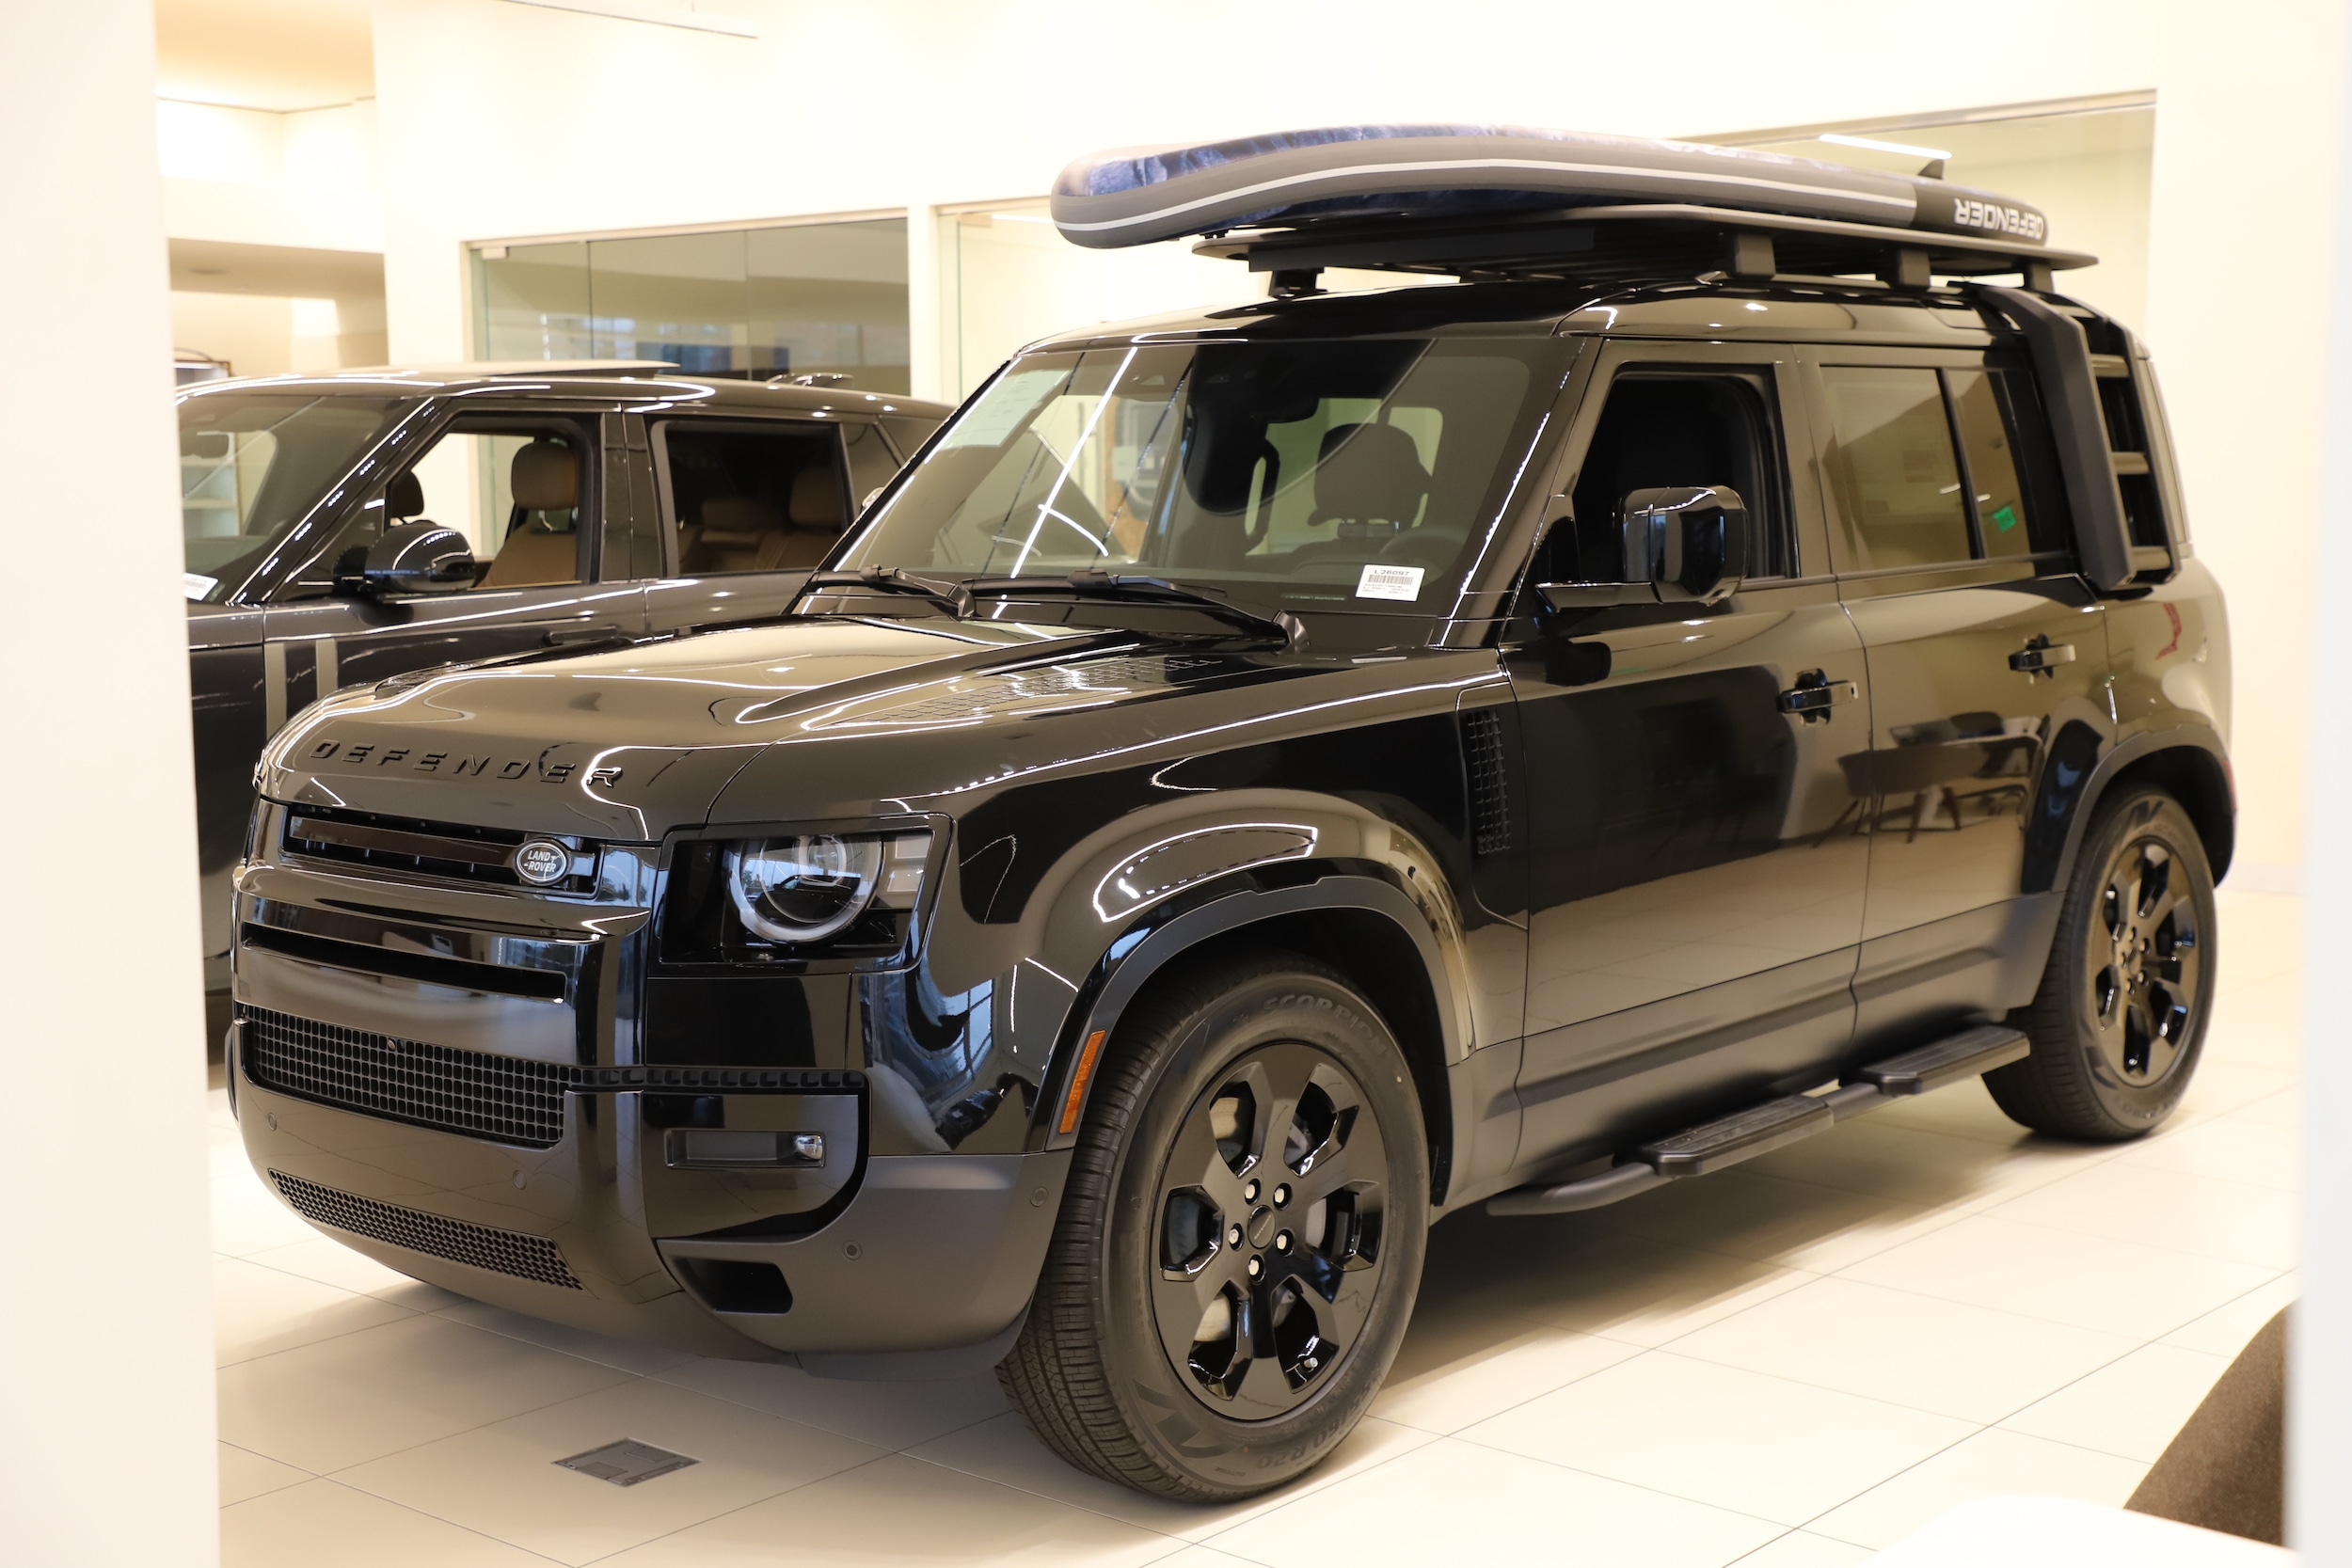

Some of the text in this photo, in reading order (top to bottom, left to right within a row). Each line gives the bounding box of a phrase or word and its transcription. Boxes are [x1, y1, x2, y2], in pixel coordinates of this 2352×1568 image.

[1954, 198, 2043, 240] DEFENDER
[309, 739, 623, 787] DEFENDER
[527, 849, 551, 861] LAND
[527, 862, 557, 873] ROVER
[1263, 994, 1388, 1054] SCORPION
